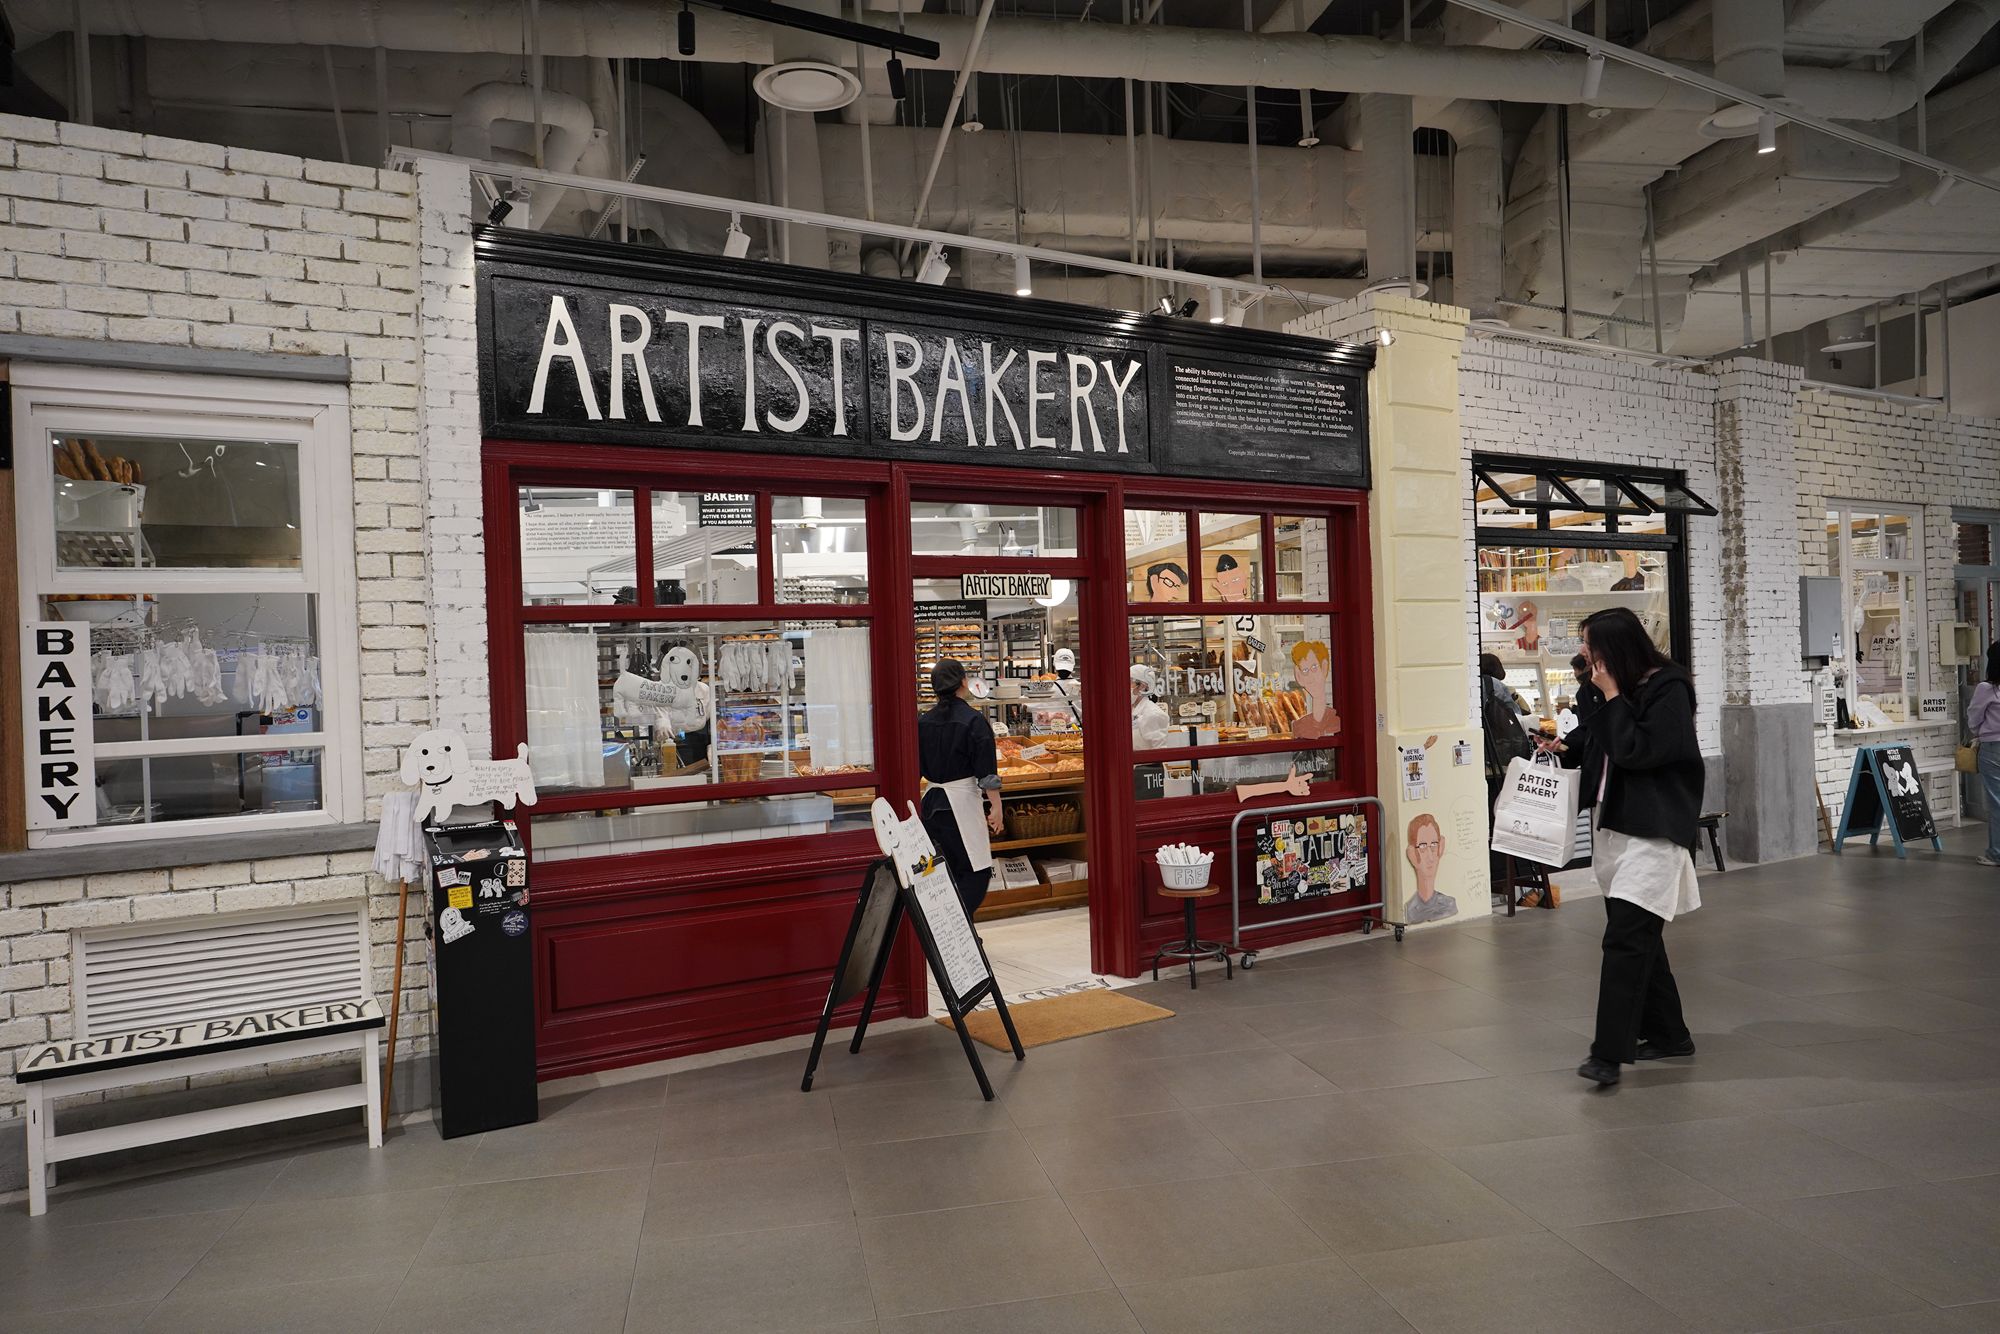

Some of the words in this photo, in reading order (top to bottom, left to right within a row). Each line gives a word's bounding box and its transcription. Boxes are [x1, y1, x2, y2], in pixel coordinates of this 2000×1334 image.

[526, 295, 860, 436] ARTIST
[885, 331, 1142, 454] BAKERY
[1174, 375, 1198, 383] connected
[1230, 380, 1248, 390] looking
[1248, 382, 1263, 390] stylish
[1184, 366, 1200, 376] ability
[1206, 369, 1226, 378] freestyle
[1269, 376, 1280, 384] days
[1175, 383, 1192, 392] writing
[1192, 384, 1212, 394] flowing
[1332, 399, 1346, 408] dough
[1188, 401, 1202, 410] living
[1218, 404, 1234, 413] always
[1234, 405, 1246, 413] have
[1256, 407, 1267, 415] have
[1267, 409, 1283, 418] always
[1286, 419, 1301, 427] people
[704, 492, 750, 501] BAKERY
[965, 576, 1009, 598] ARTIST
[1008, 575, 1050, 597] BAKERY
[1236, 614, 1254, 632] 23
[1188, 665, 1225, 694] Bread
[1923, 698, 1946, 706] ARTIST
[36, 629, 80, 819] BAKERY
[1404, 754, 1424, 762] HIRING!
[1520, 772, 1559, 788] ARTIST
[1517, 783, 1558, 799] BAKERY
[1272, 822, 1287, 834] EXIT
[499, 865, 504, 876] 1
[1174, 866, 1208, 885] FREE
[27, 1024, 196, 1068] ARTIST
[203, 999, 374, 1042] BAKERY
